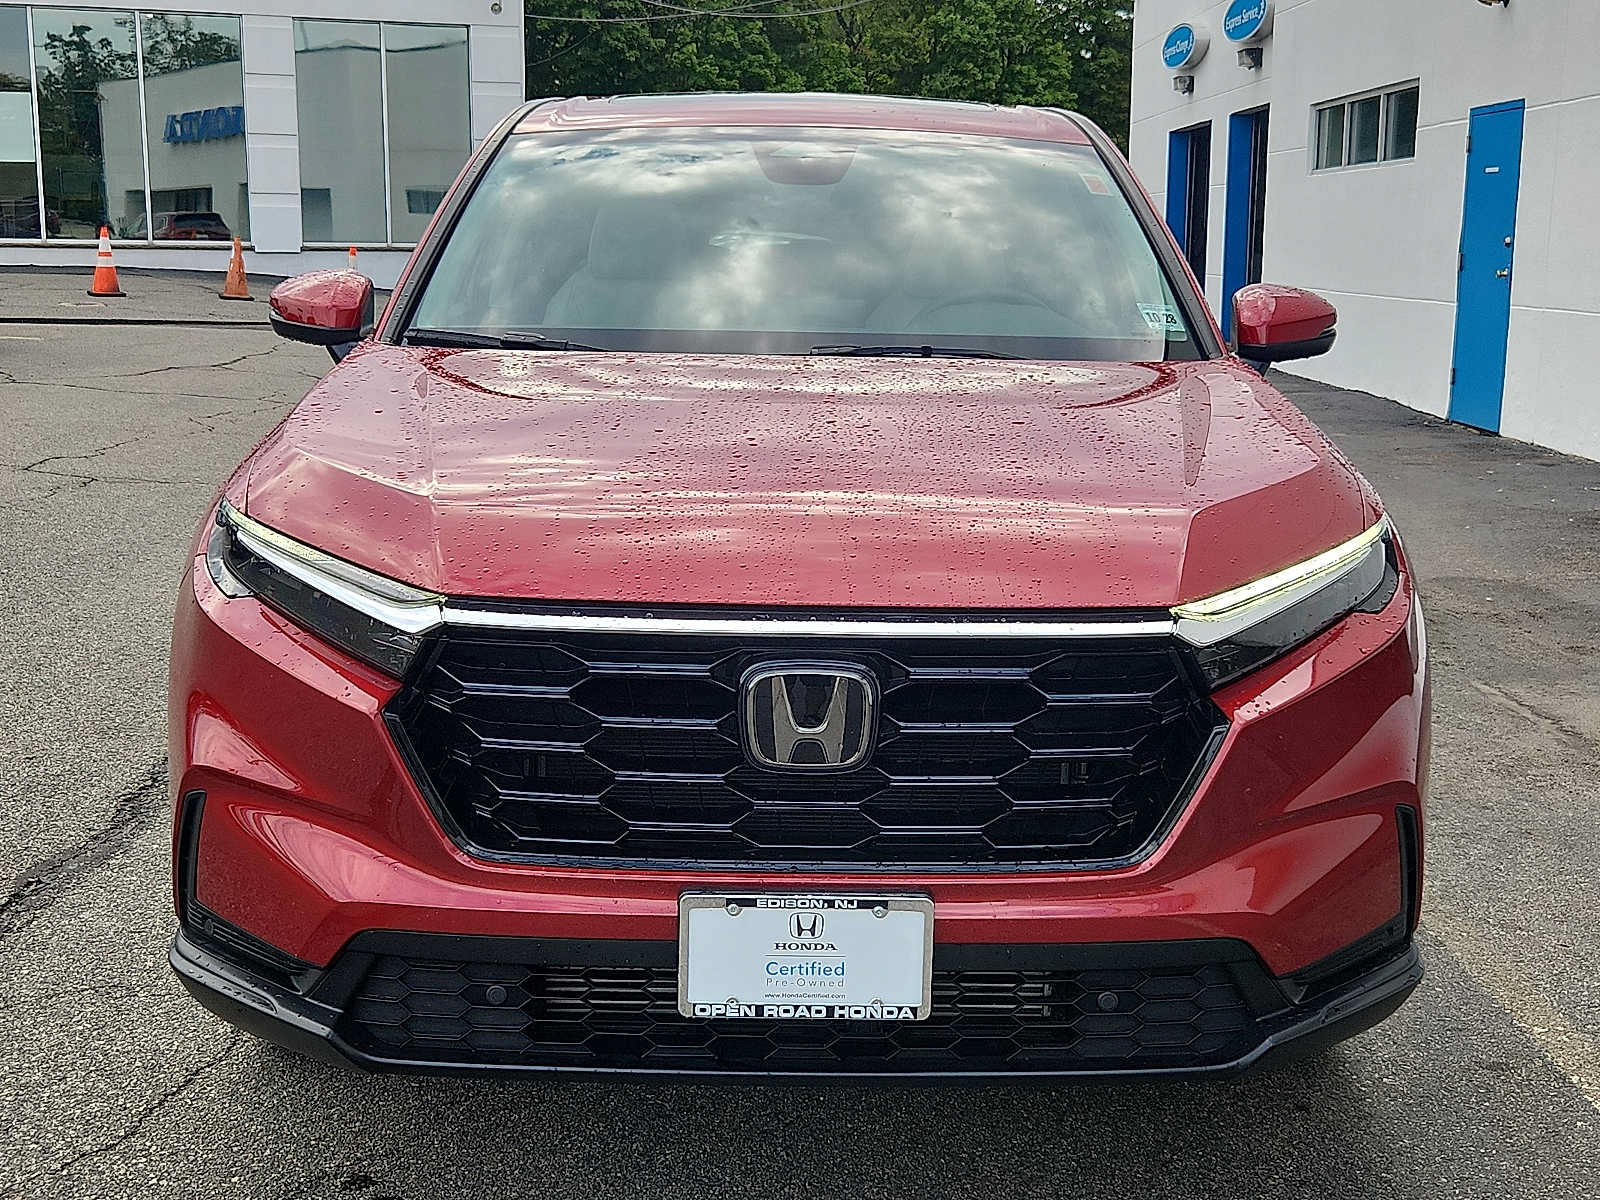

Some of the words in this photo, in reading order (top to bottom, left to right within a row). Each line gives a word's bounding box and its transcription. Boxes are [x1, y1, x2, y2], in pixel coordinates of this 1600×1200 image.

[1145, 312, 1161, 323] 10
[1162, 313, 1177, 324] 28
[756, 898, 828, 909] EDISON,
[834, 899, 858, 909] NJ
[774, 942, 838, 951] HONDA
[765, 961, 845, 977] Certified
[766, 978, 844, 988] Pre-Owned
[694, 1003, 756, 1017] OPEN
[763, 1004, 827, 1018] ROAD
[833, 1005, 915, 1019] HONDA
